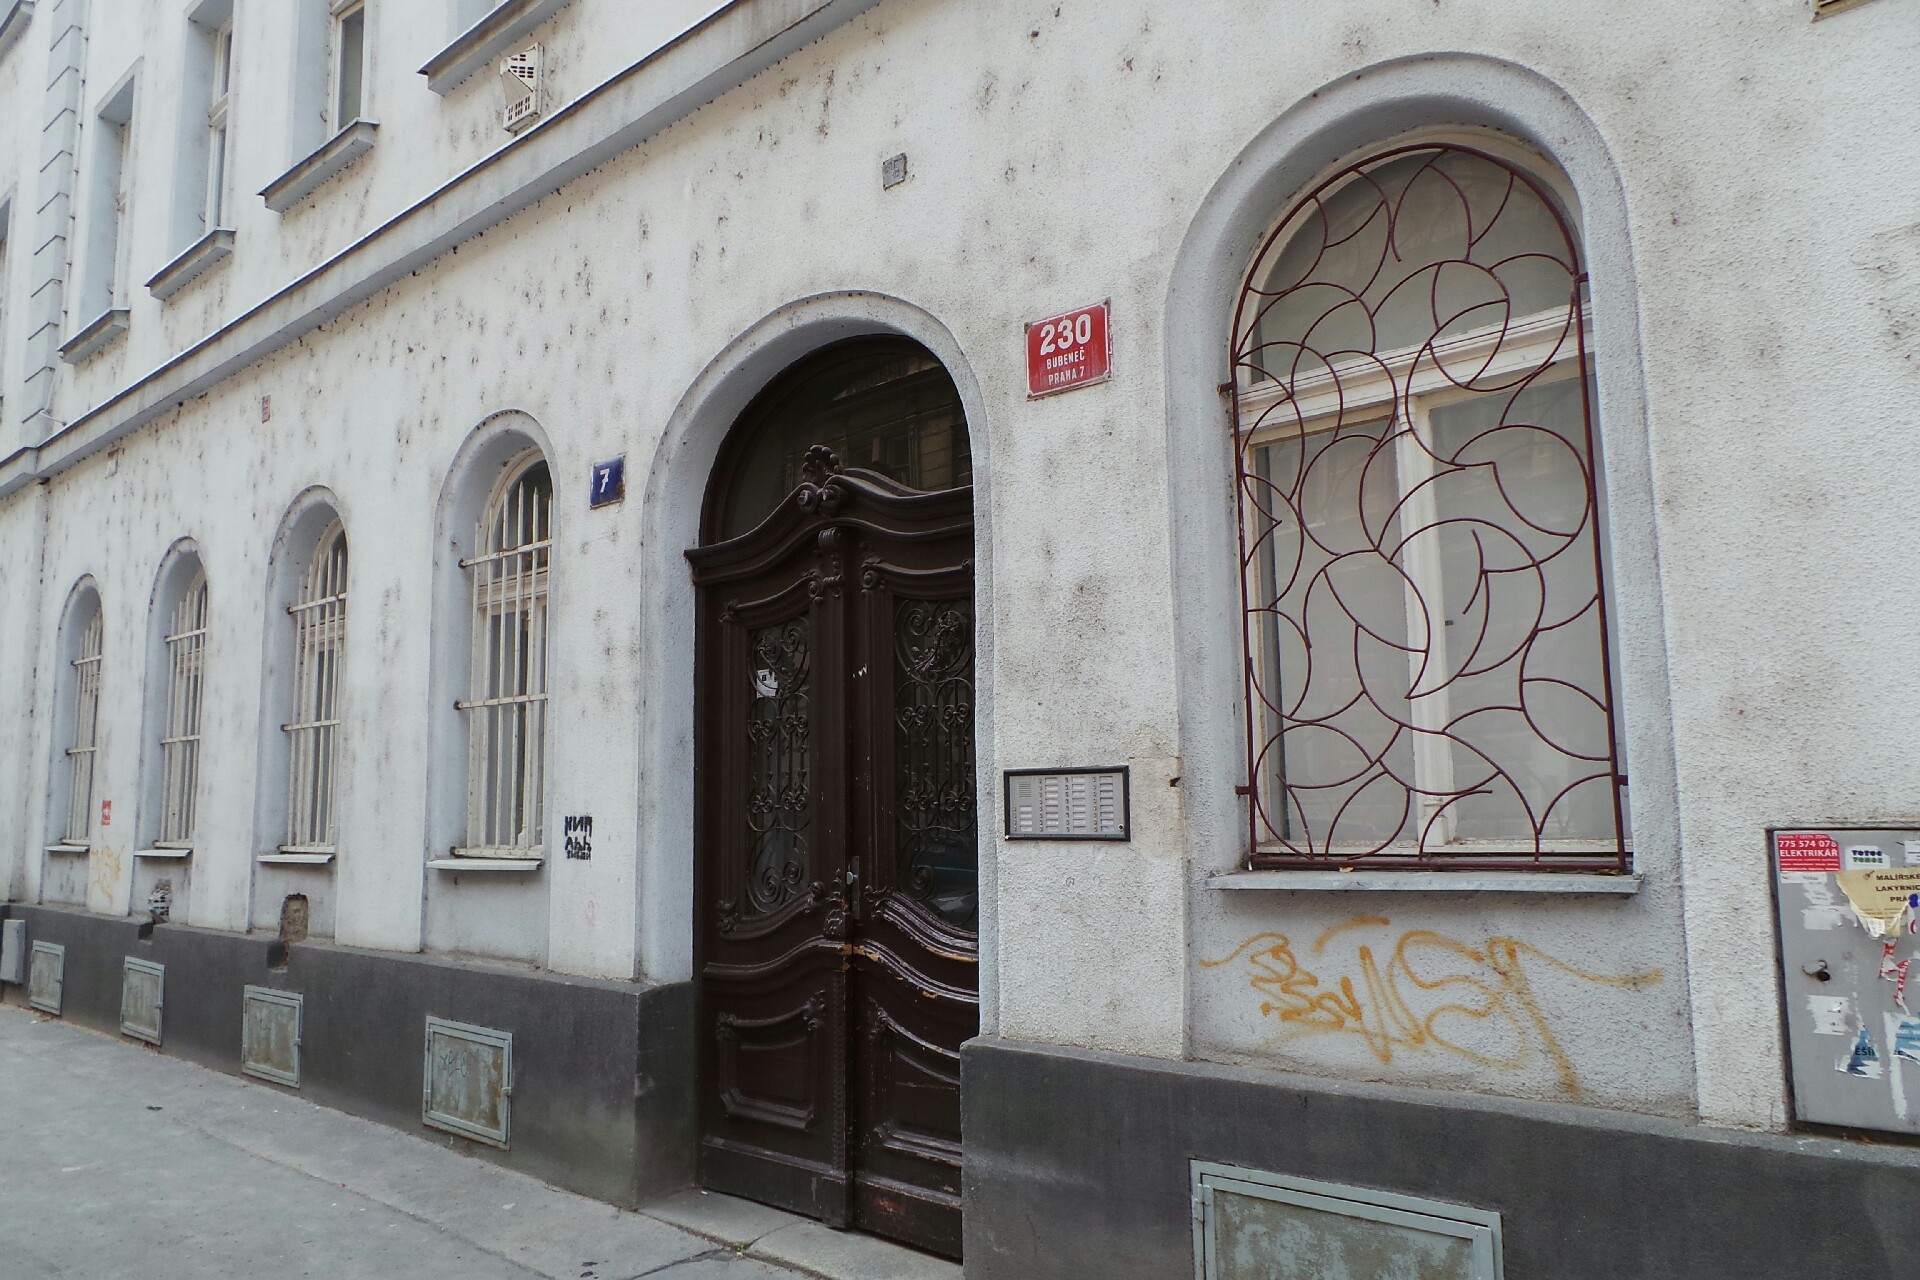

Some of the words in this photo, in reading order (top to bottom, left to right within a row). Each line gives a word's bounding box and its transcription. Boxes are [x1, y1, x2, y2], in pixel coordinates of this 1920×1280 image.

[1040, 313, 1091, 355] 230
[1046, 346, 1085, 369] BUBENEČ
[1048, 368, 1077, 386] PRAHA
[1079, 366, 1085, 378] 7
[600, 468, 610, 493] 7
[1779, 840, 1796, 848] 775
[1799, 840, 1816, 848] 574
[1818, 840, 1837, 848] 078
